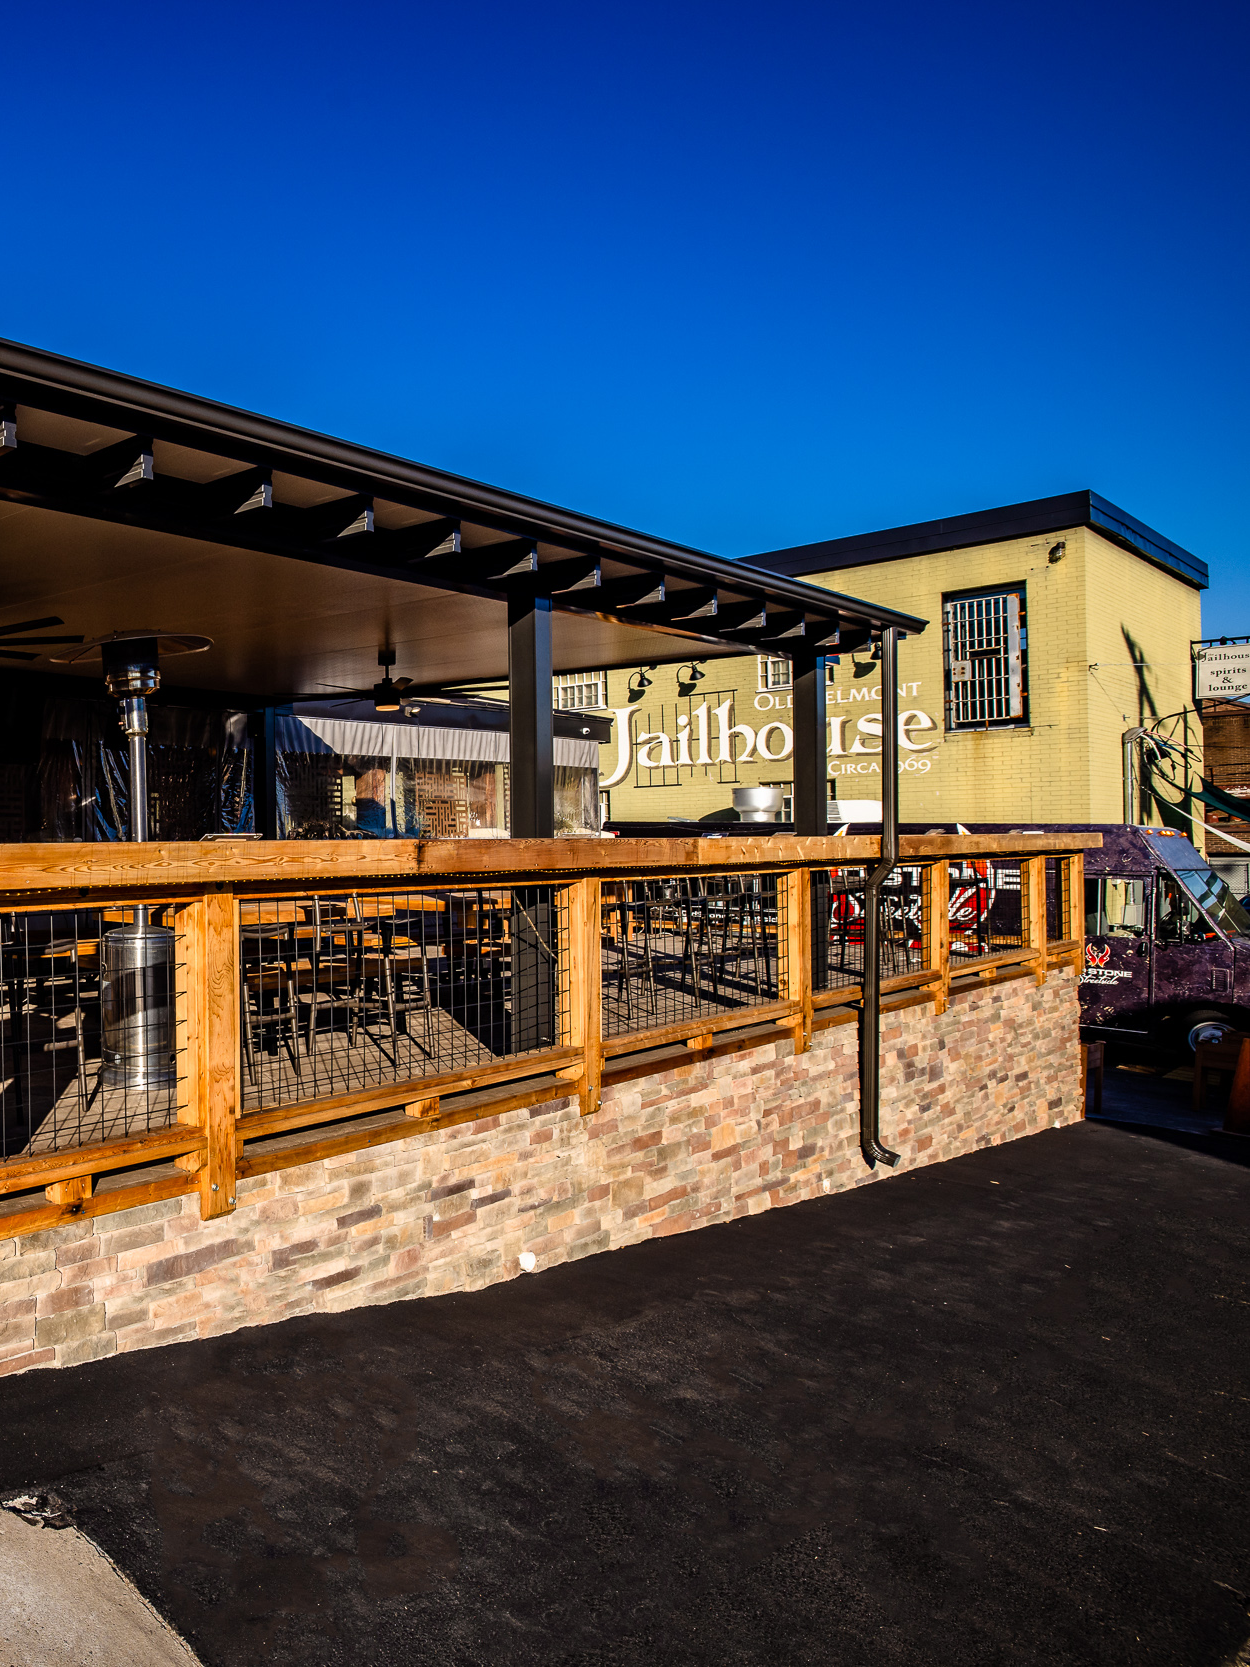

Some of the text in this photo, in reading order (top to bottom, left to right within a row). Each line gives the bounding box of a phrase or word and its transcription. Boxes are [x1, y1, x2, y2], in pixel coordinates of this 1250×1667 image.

[1200, 652, 1250, 663] Jailhous
[1210, 667, 1248, 678] spirits
[825, 682, 922, 704] ELMONT
[1208, 684, 1249, 692] lounge
[827, 756, 932, 775] CIRCA 69
